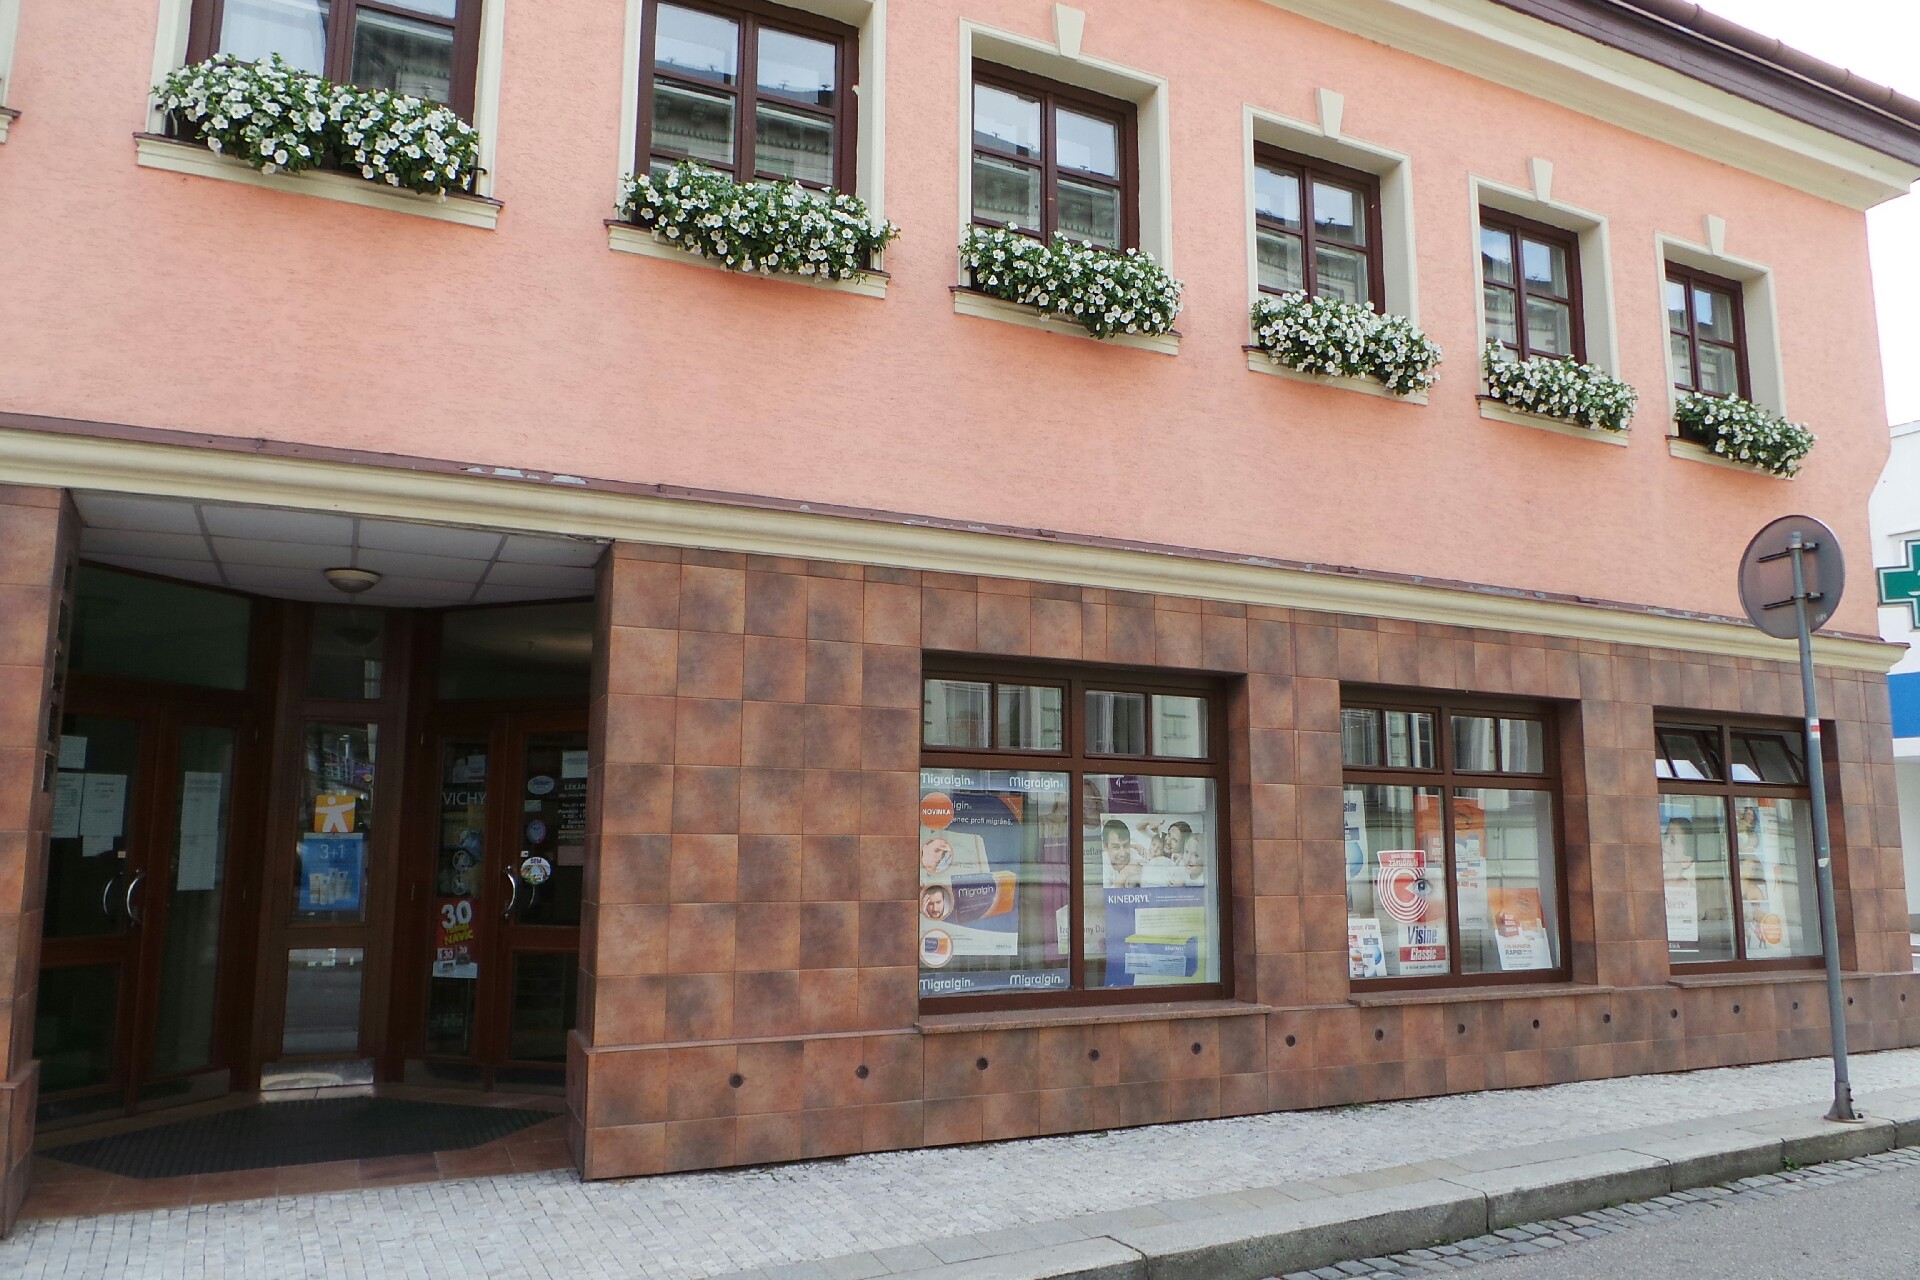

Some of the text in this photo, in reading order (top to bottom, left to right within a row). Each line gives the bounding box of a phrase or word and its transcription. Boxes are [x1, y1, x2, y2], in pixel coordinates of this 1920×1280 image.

[920, 772, 970, 786] Migralgin
[1009, 776, 1059, 789] Migralgin
[442, 791, 487, 805] VICHY
[958, 885, 994, 897] Migralgin
[1108, 894, 1150, 904] KINEDRYL
[441, 900, 472, 929] 30
[1408, 925, 1437, 944] Visine
[919, 977, 970, 991] Migralgin
[1010, 974, 1060, 986] Migralgin
